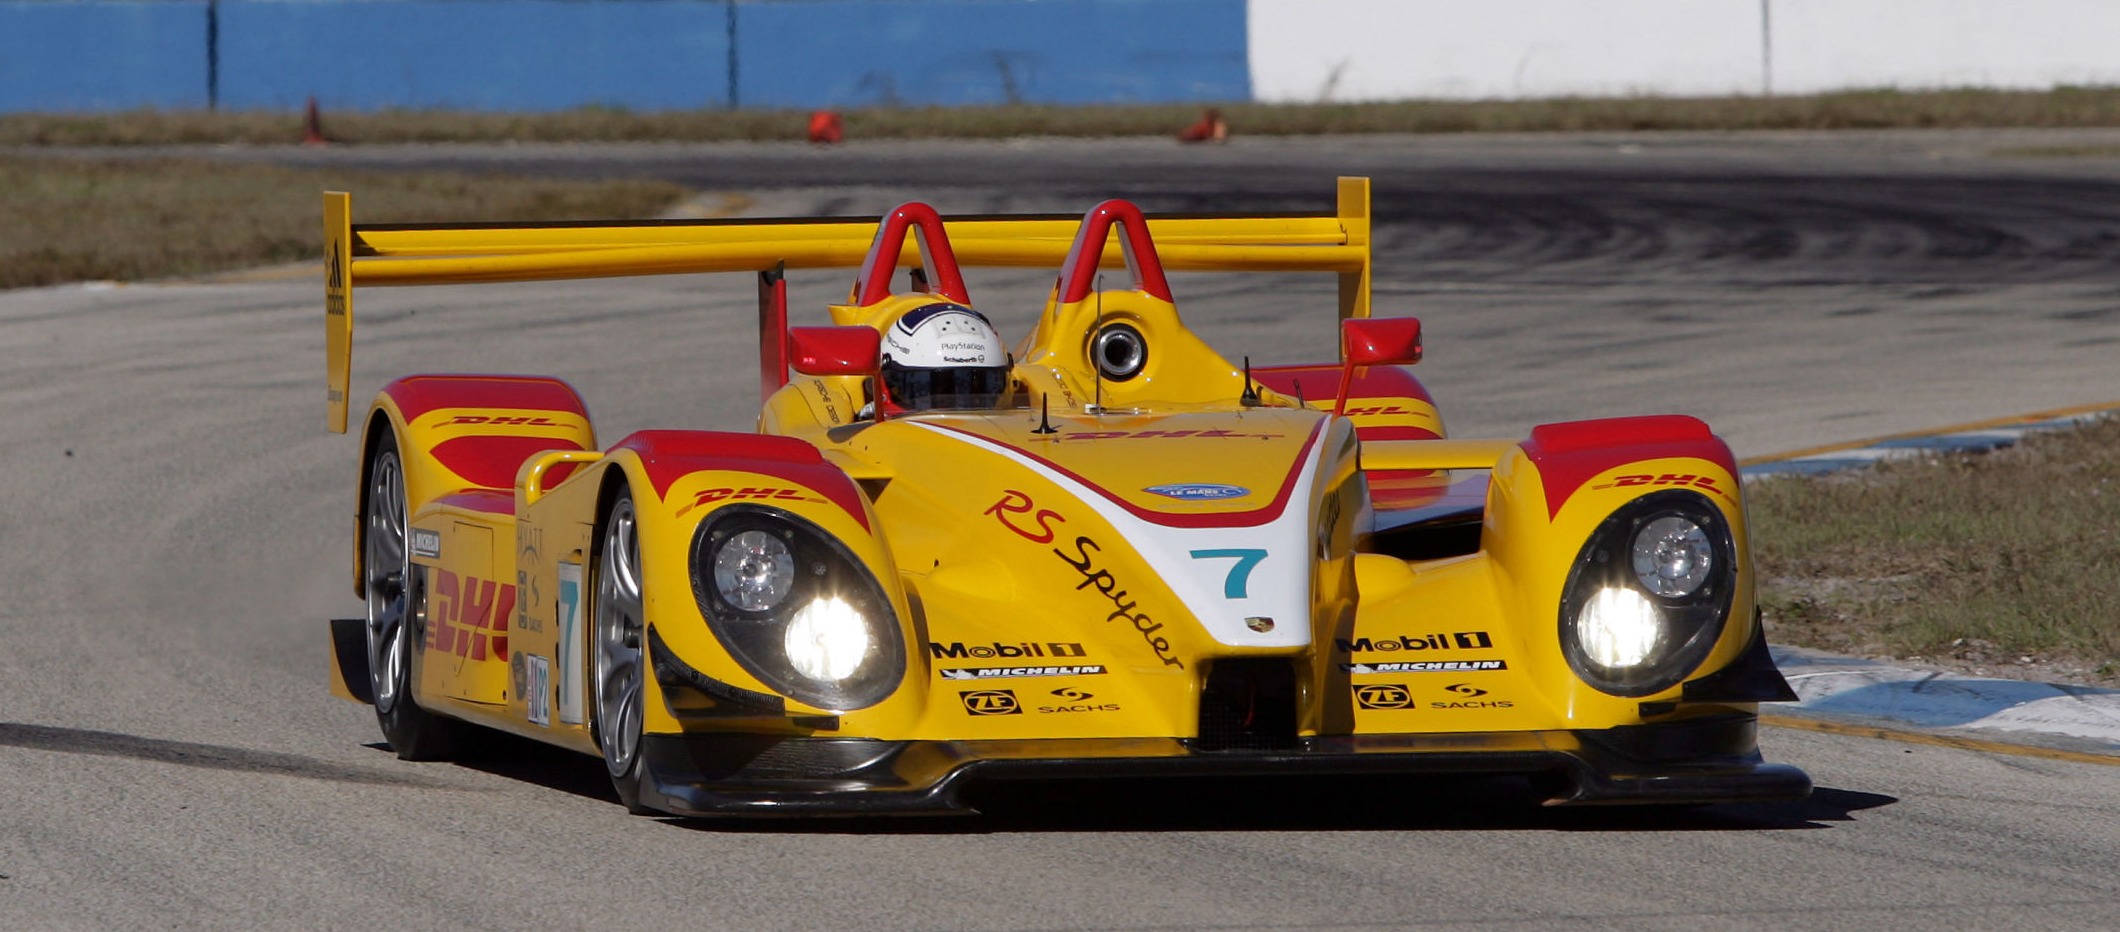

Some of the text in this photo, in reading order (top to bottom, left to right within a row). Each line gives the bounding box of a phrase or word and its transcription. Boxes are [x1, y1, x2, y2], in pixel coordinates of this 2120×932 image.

[452, 416, 557, 427] DHL
[1066, 430, 1247, 440] DHL
[1614, 474, 1723, 495] DHL
[694, 488, 806, 507] DHL
[984, 489, 1185, 670] RS Spyder
[1189, 548, 1269, 599] 7
[560, 579, 579, 705] 7
[930, 642, 1045, 659] Mobil
[1335, 633, 1450, 652] Mobil
[978, 666, 1101, 677] MICHELIN
[1377, 661, 1501, 671] MICHELIN
[538, 667, 548, 717] P2
[1363, 689, 1514, 709] ZF SACHS
[967, 694, 1121, 714] ZF SACHS
